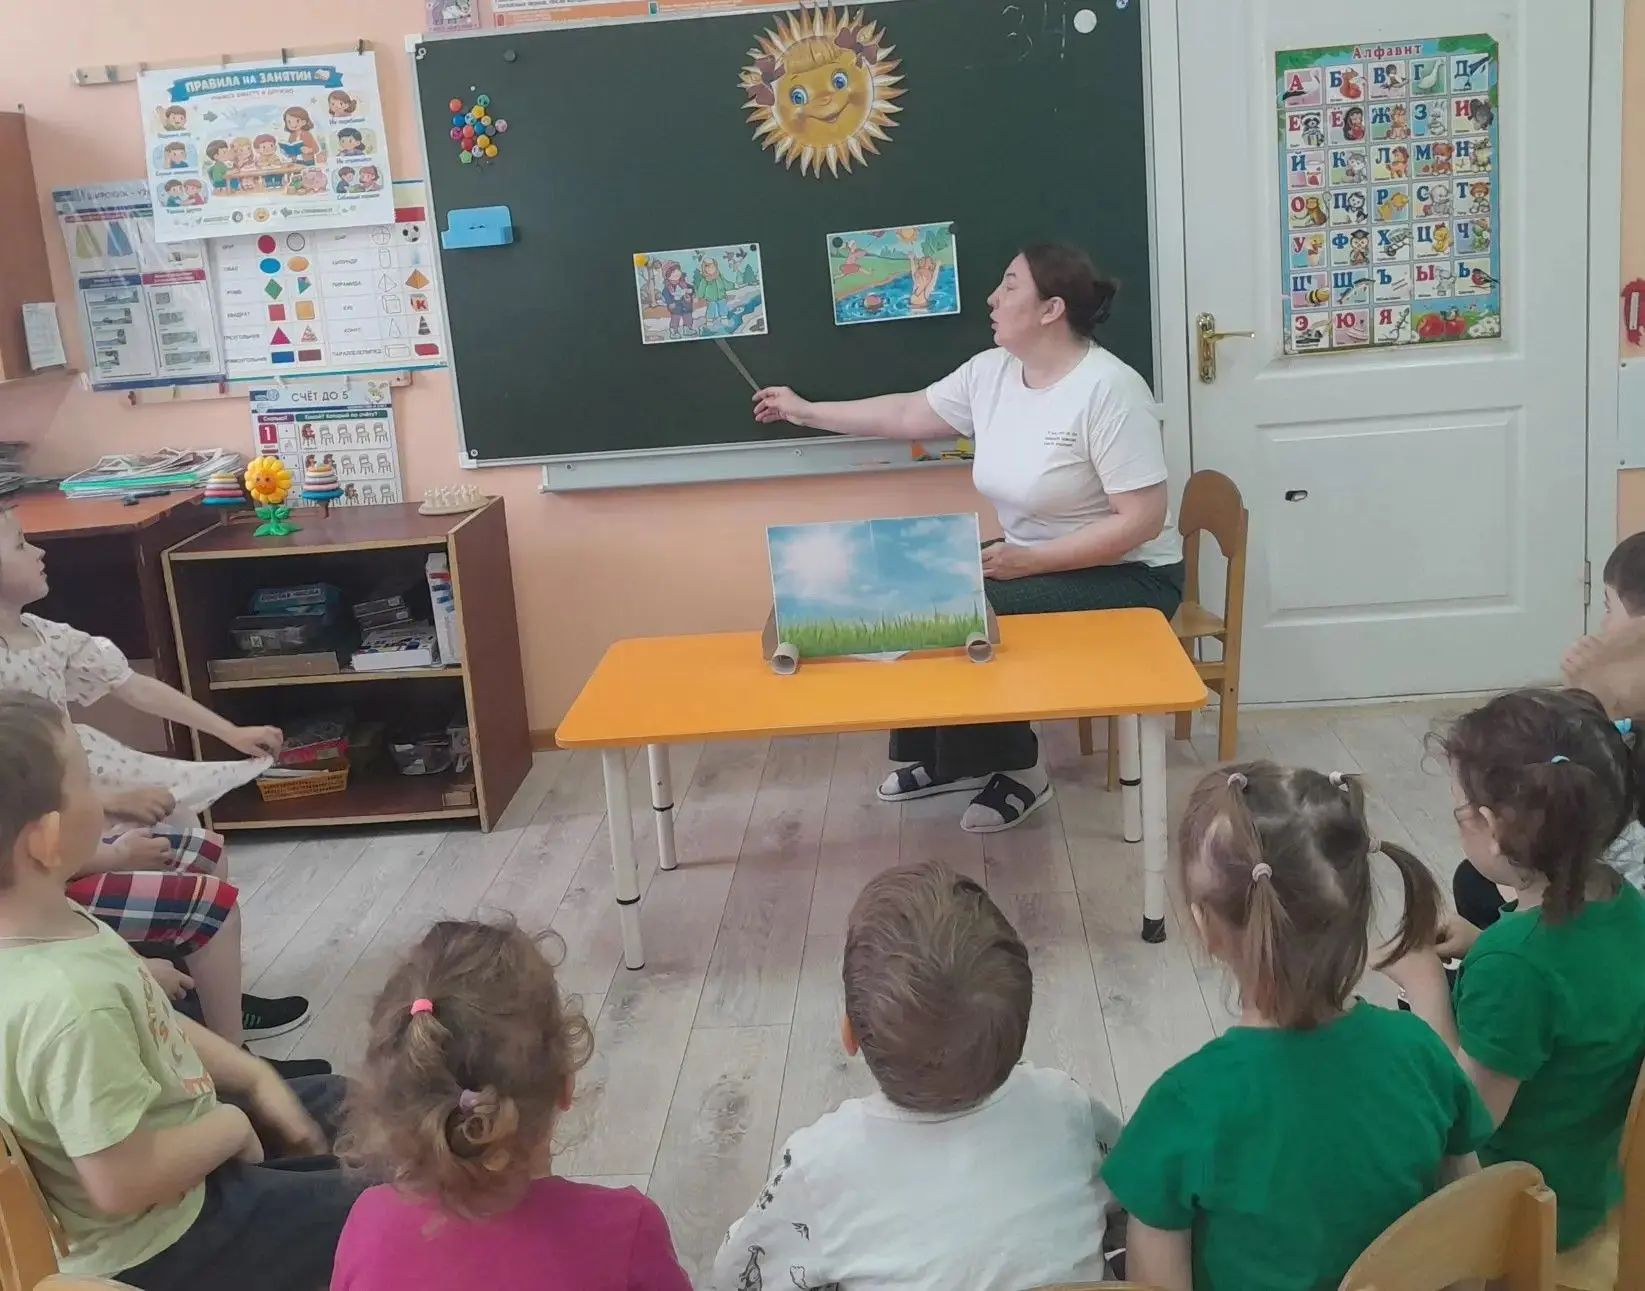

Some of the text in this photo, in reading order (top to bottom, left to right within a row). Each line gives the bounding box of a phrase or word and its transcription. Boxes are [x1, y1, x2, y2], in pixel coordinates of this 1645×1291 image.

[1353, 45, 1422, 60] Алфавит
[185, 75, 241, 93] ПРАВИЛА
[1289, 60, 1470, 90] А Б В Г Д
[1288, 114, 1301, 131] Е
[1331, 107, 1344, 127] Ё
[1371, 107, 1391, 124] Ж
[1414, 104, 1427, 120] З
[1291, 141, 1469, 171] Й К Л М Н
[1291, 182, 1468, 212] О П Р С Т
[1293, 223, 1469, 252] У Ф Х Ц Ч
[1333, 271, 1354, 288] Щ
[1376, 268, 1392, 284] Ъ
[1416, 264, 1435, 281] Ы
[1458, 262, 1470, 278] Ь
[1295, 308, 1392, 331] Э Ю Я
[291, 389, 349, 402] СЧЁТ ДО 5
[264, 426, 271, 441] 1
